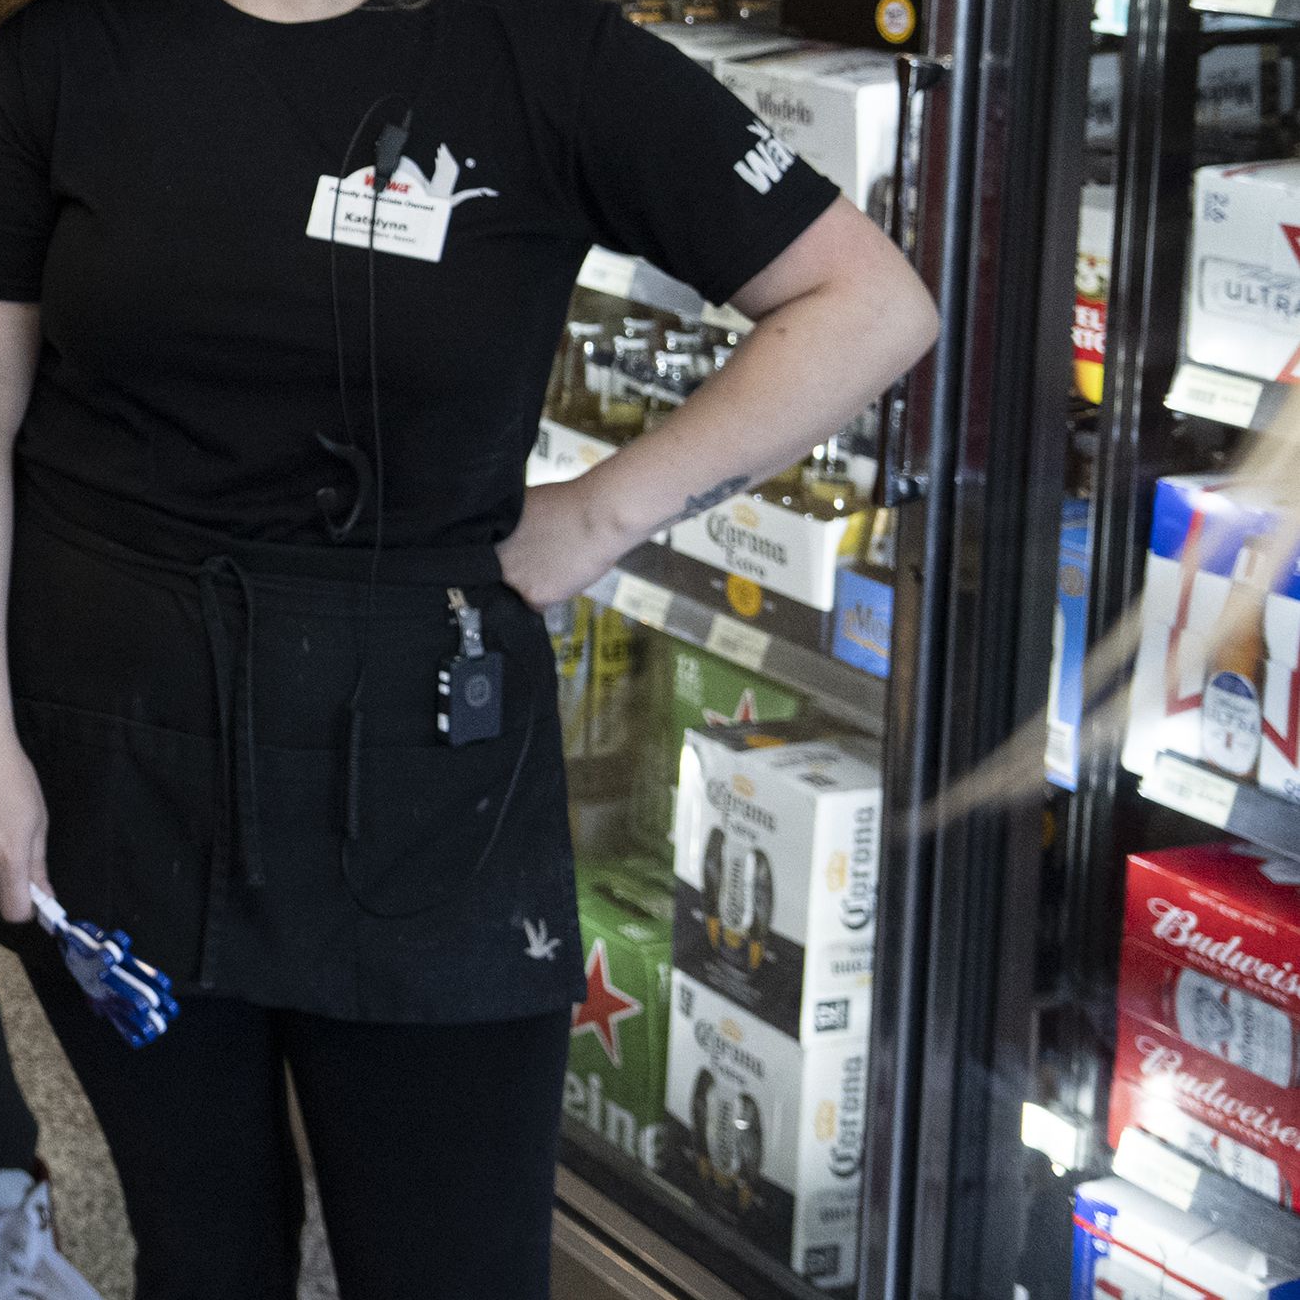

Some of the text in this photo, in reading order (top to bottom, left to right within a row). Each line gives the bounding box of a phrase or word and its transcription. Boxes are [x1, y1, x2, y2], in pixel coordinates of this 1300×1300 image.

[364, 173, 410, 194] Wwa
[733, 138, 797, 195] Wa
[706, 512, 789, 567] Corona
[707, 777, 776, 833] Corona
[838, 806, 876, 931] Corona
[695, 1018, 765, 1080] Corona
[827, 1056, 864, 1179] Corona
